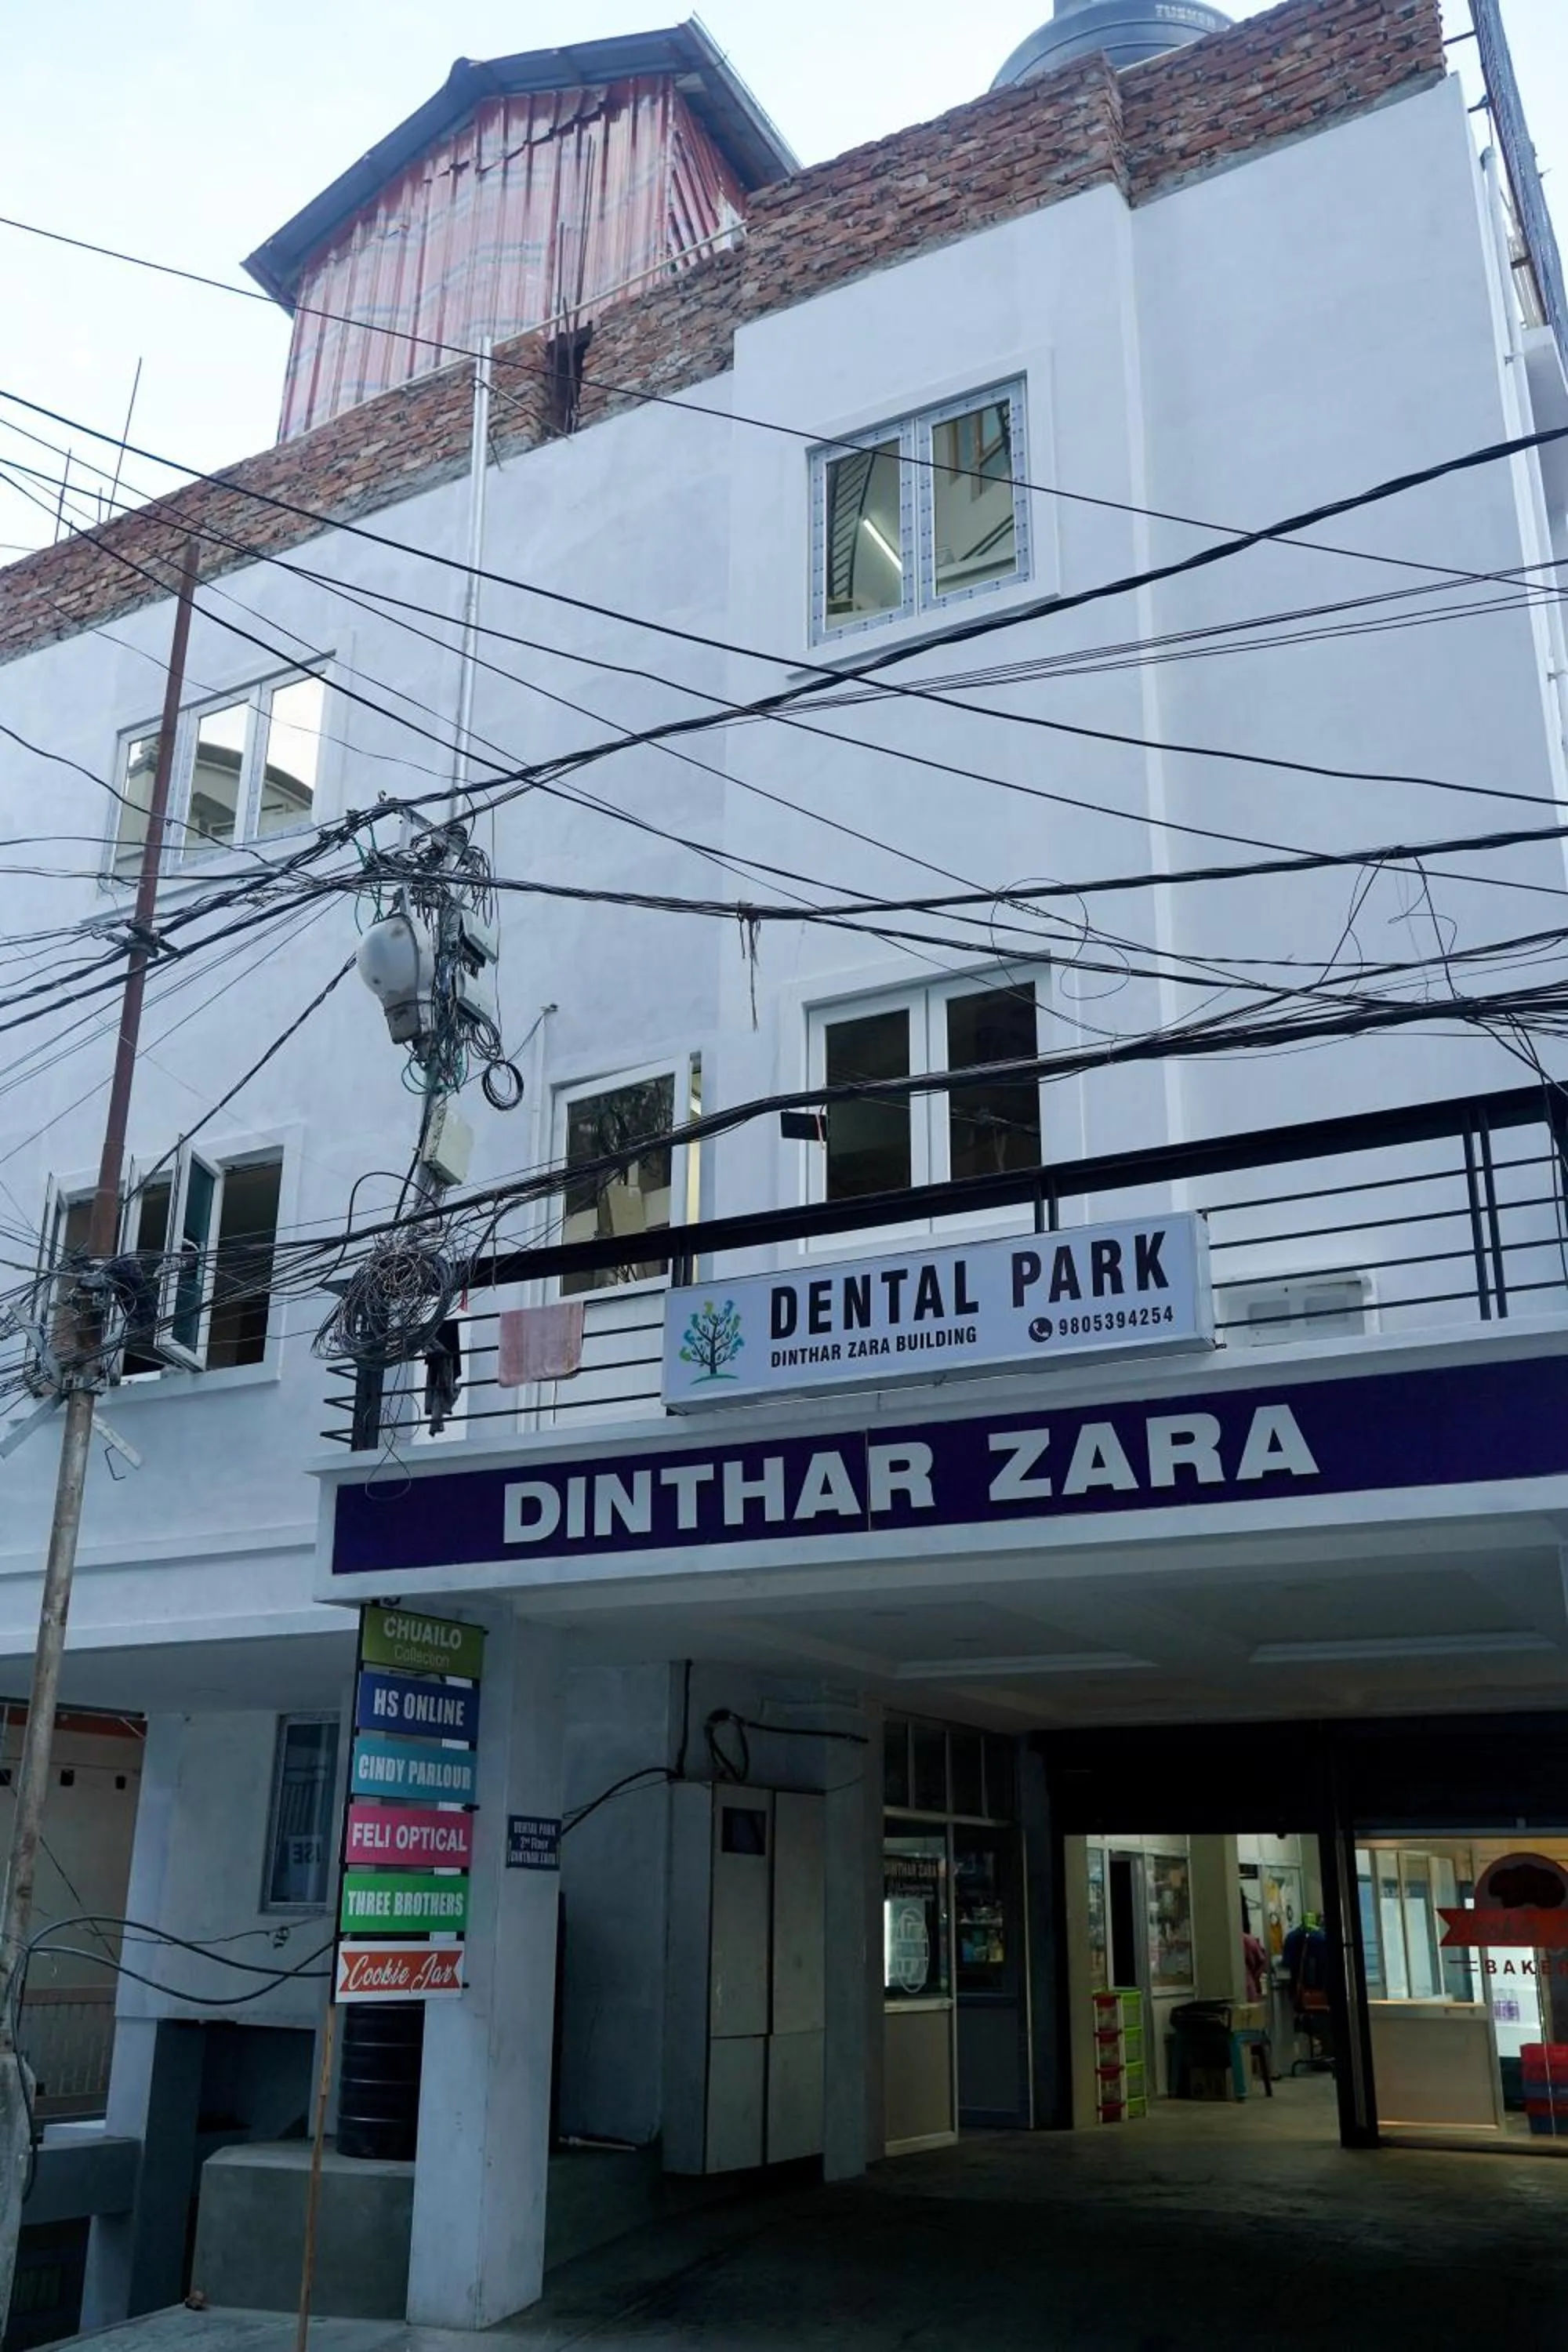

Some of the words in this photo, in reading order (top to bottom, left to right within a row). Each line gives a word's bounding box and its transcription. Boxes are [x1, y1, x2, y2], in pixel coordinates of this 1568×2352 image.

[770, 1259, 979, 1340] DENTAL
[1011, 1231, 1170, 1308] PARK
[1058, 1305, 1174, 1335] 9805394254
[771, 1343, 841, 1368] DINTHAR
[848, 1337, 891, 1359] ZARA
[896, 1327, 977, 1352] BUILDING
[502, 1441, 935, 1544] DINTHAR
[988, 1403, 1319, 1502] ZARA
[383, 1616, 463, 1650] CHUAILO
[373, 1688, 398, 1717] HS
[404, 1693, 465, 1726] ONLINE
[358, 1755, 405, 1782] CINDY
[408, 1761, 471, 1790] PARLOUR
[353, 1823, 390, 1848] FELI
[396, 1826, 467, 1852] OPTICAL
[348, 1891, 390, 1915] THREE
[394, 1891, 464, 1916] BROTHERS
[348, 1955, 409, 1990] Cookie
